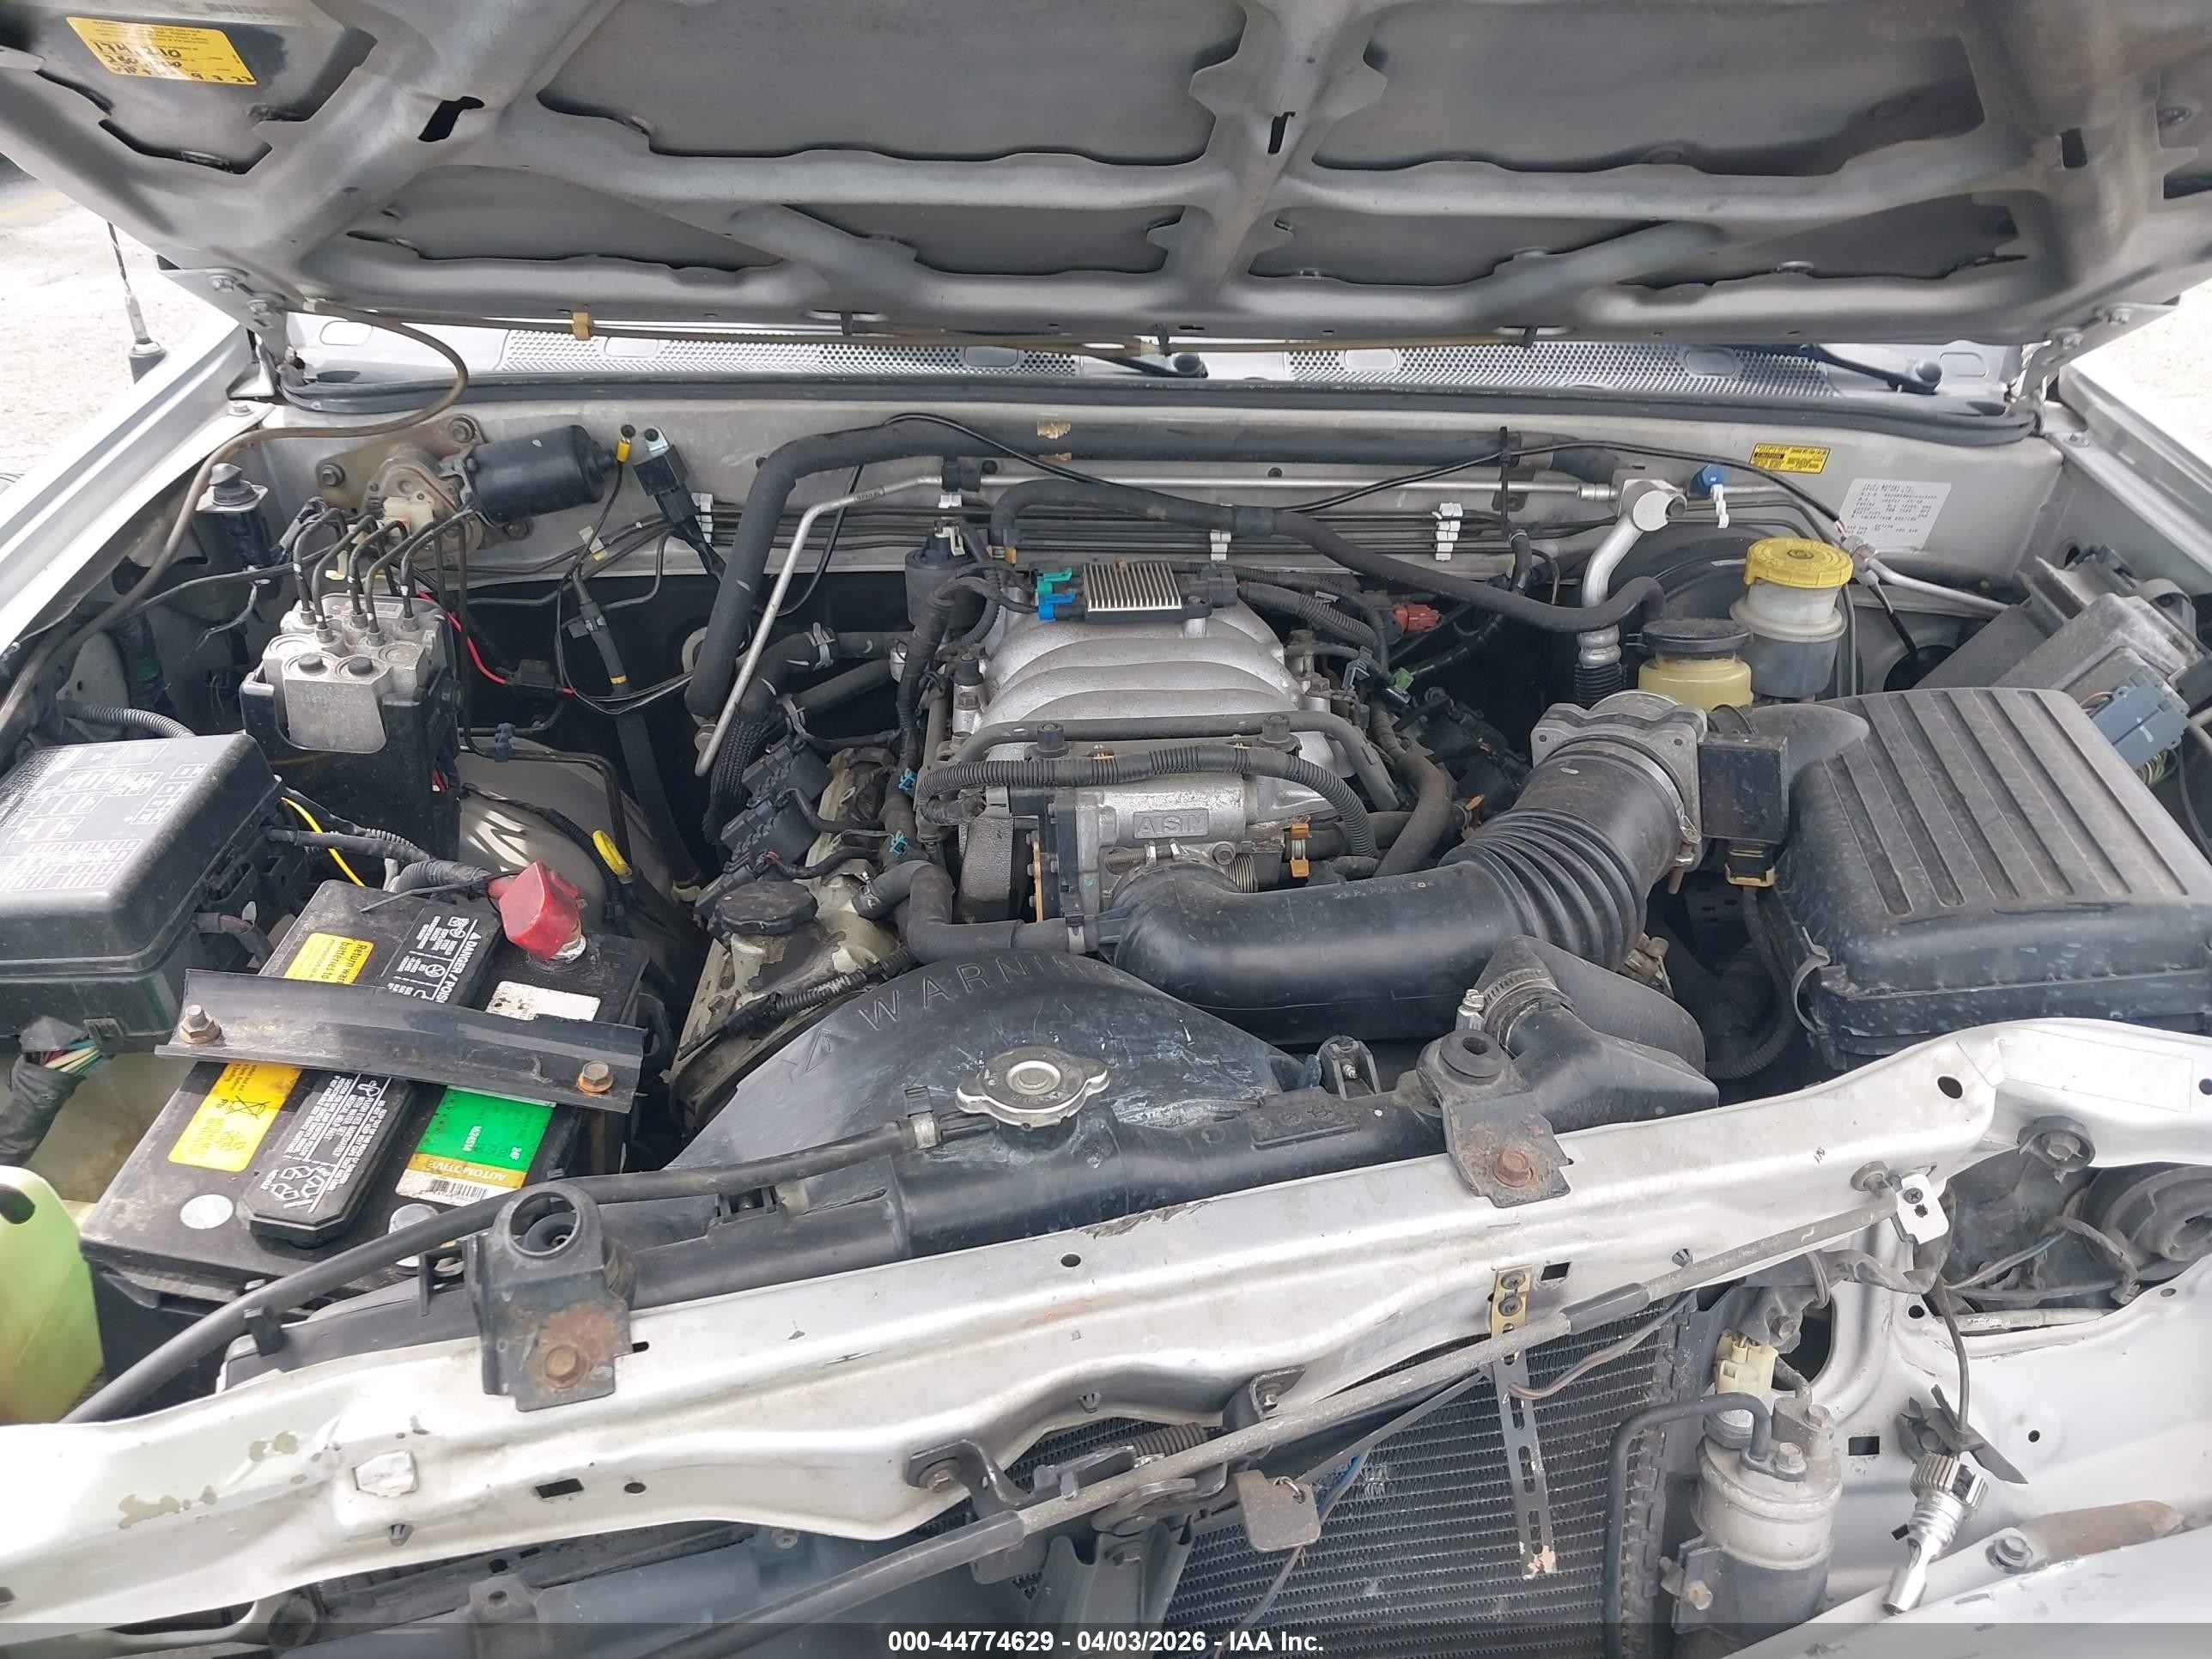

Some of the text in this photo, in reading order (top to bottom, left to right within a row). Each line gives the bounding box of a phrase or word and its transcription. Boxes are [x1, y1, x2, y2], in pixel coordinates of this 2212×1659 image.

[1138, 813, 1205, 834] AISIN
[325, 941, 352, 971] batteries
[345, 944, 368, 968] Return
[450, 940, 477, 973] DANGER
[434, 981, 455, 1002] POIS
[216, 1098, 228, 1109] Pb
[338, 1094, 357, 1114] MEDICAL
[331, 1115, 343, 1127] HELP
[331, 1097, 374, 1157] FLUSH EYES IMMEDIATELY
[335, 1126, 346, 1135] GET
[427, 1160, 507, 1182] AUTOMOTIVE
